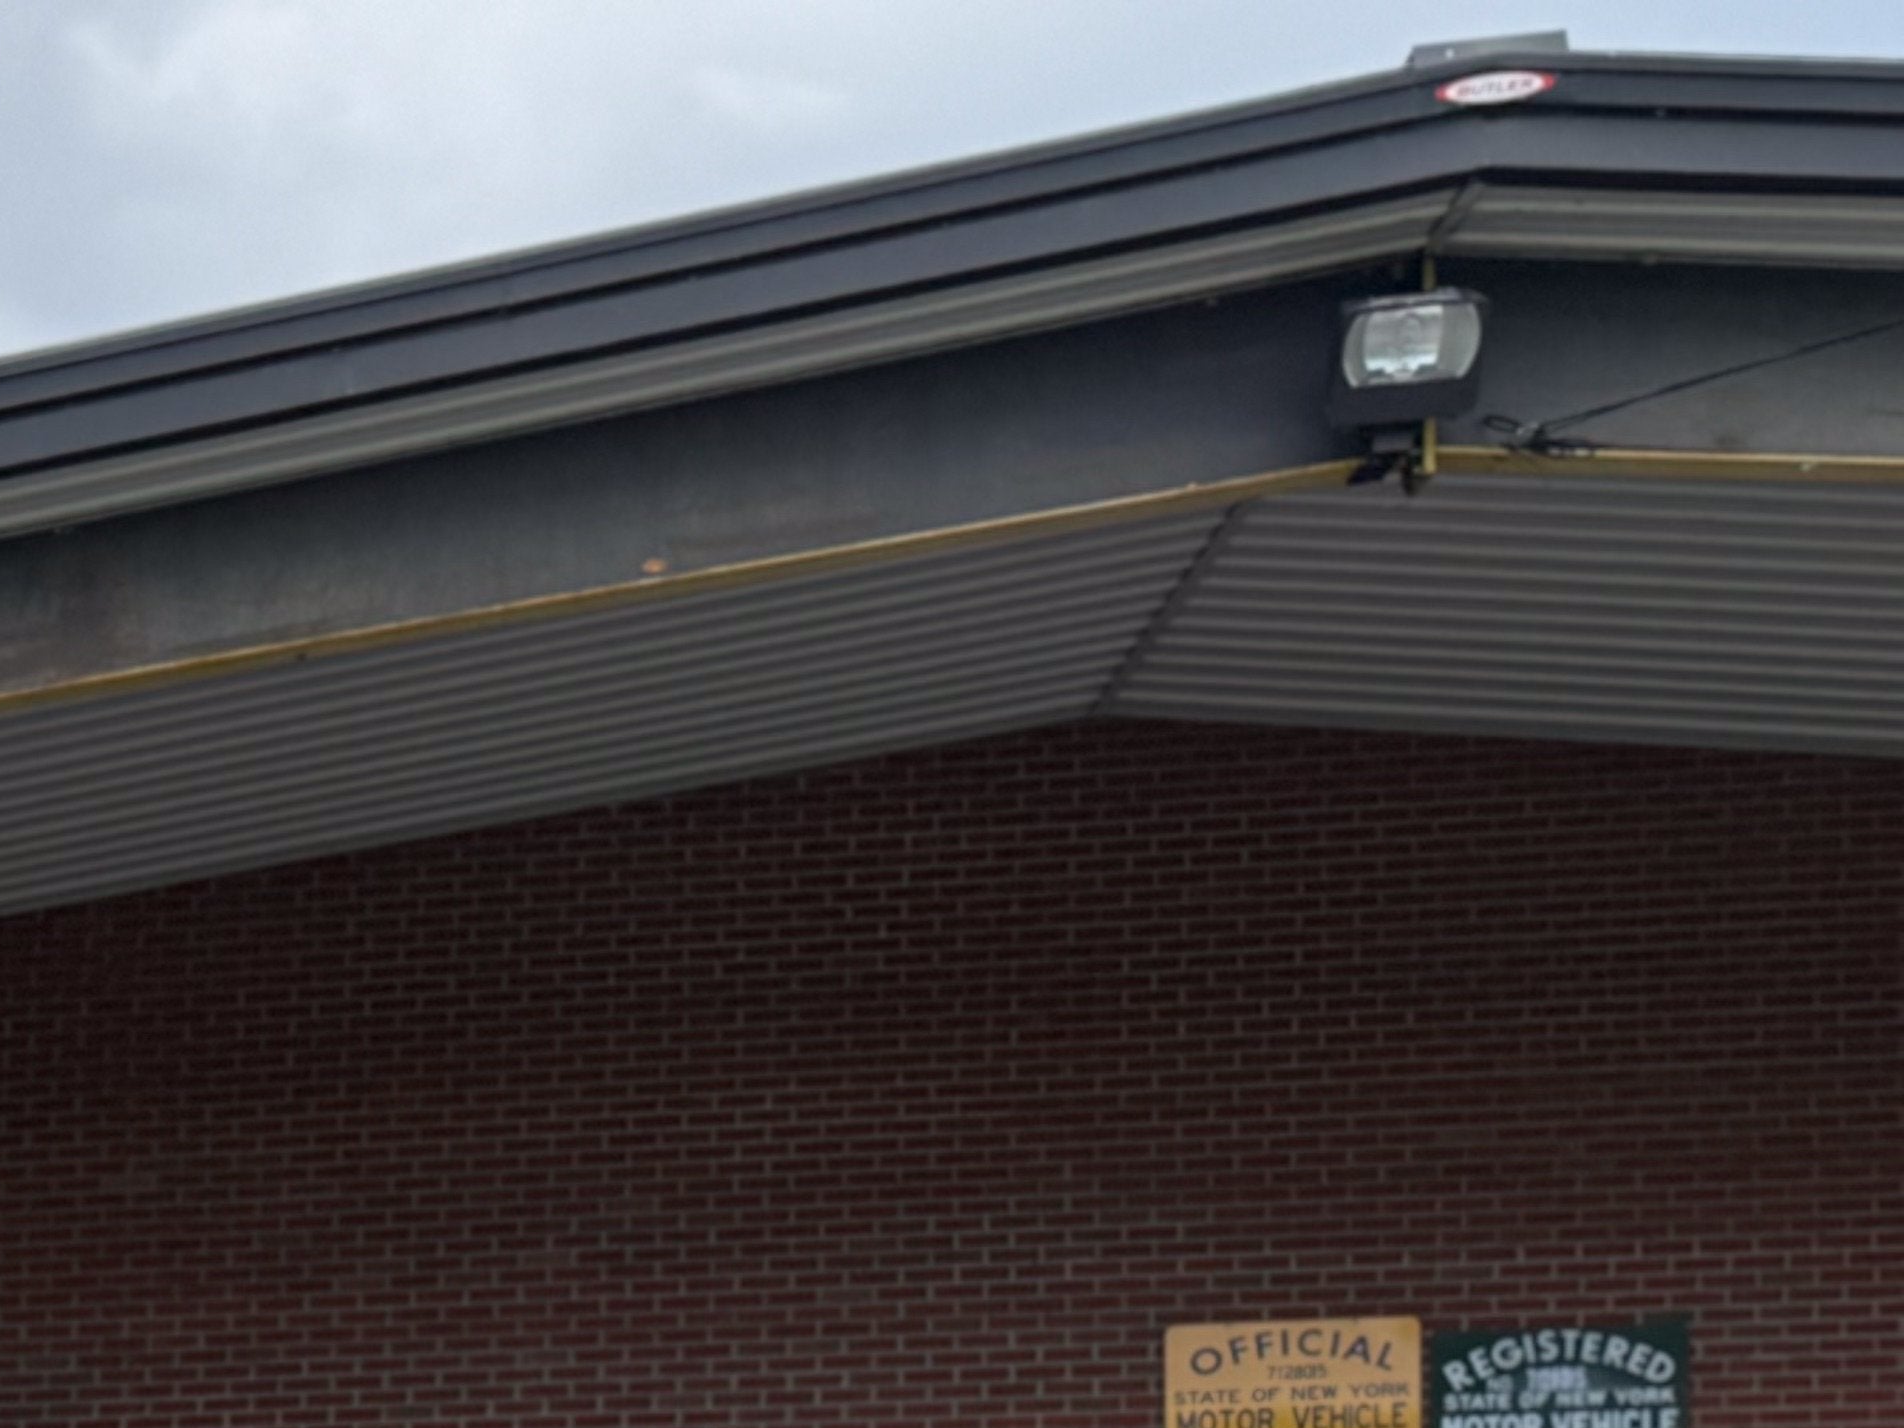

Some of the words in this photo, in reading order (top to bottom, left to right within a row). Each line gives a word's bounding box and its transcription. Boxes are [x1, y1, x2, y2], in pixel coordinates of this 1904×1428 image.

[1190, 1328, 1393, 1376] OFFICIAL
[1443, 1328, 1676, 1391] REGISTERED
[1174, 1389, 1240, 1406] STATE
[1252, 1387, 1279, 1402] OF
[1291, 1385, 1338, 1400] NEW
[1350, 1382, 1409, 1397] YORK
